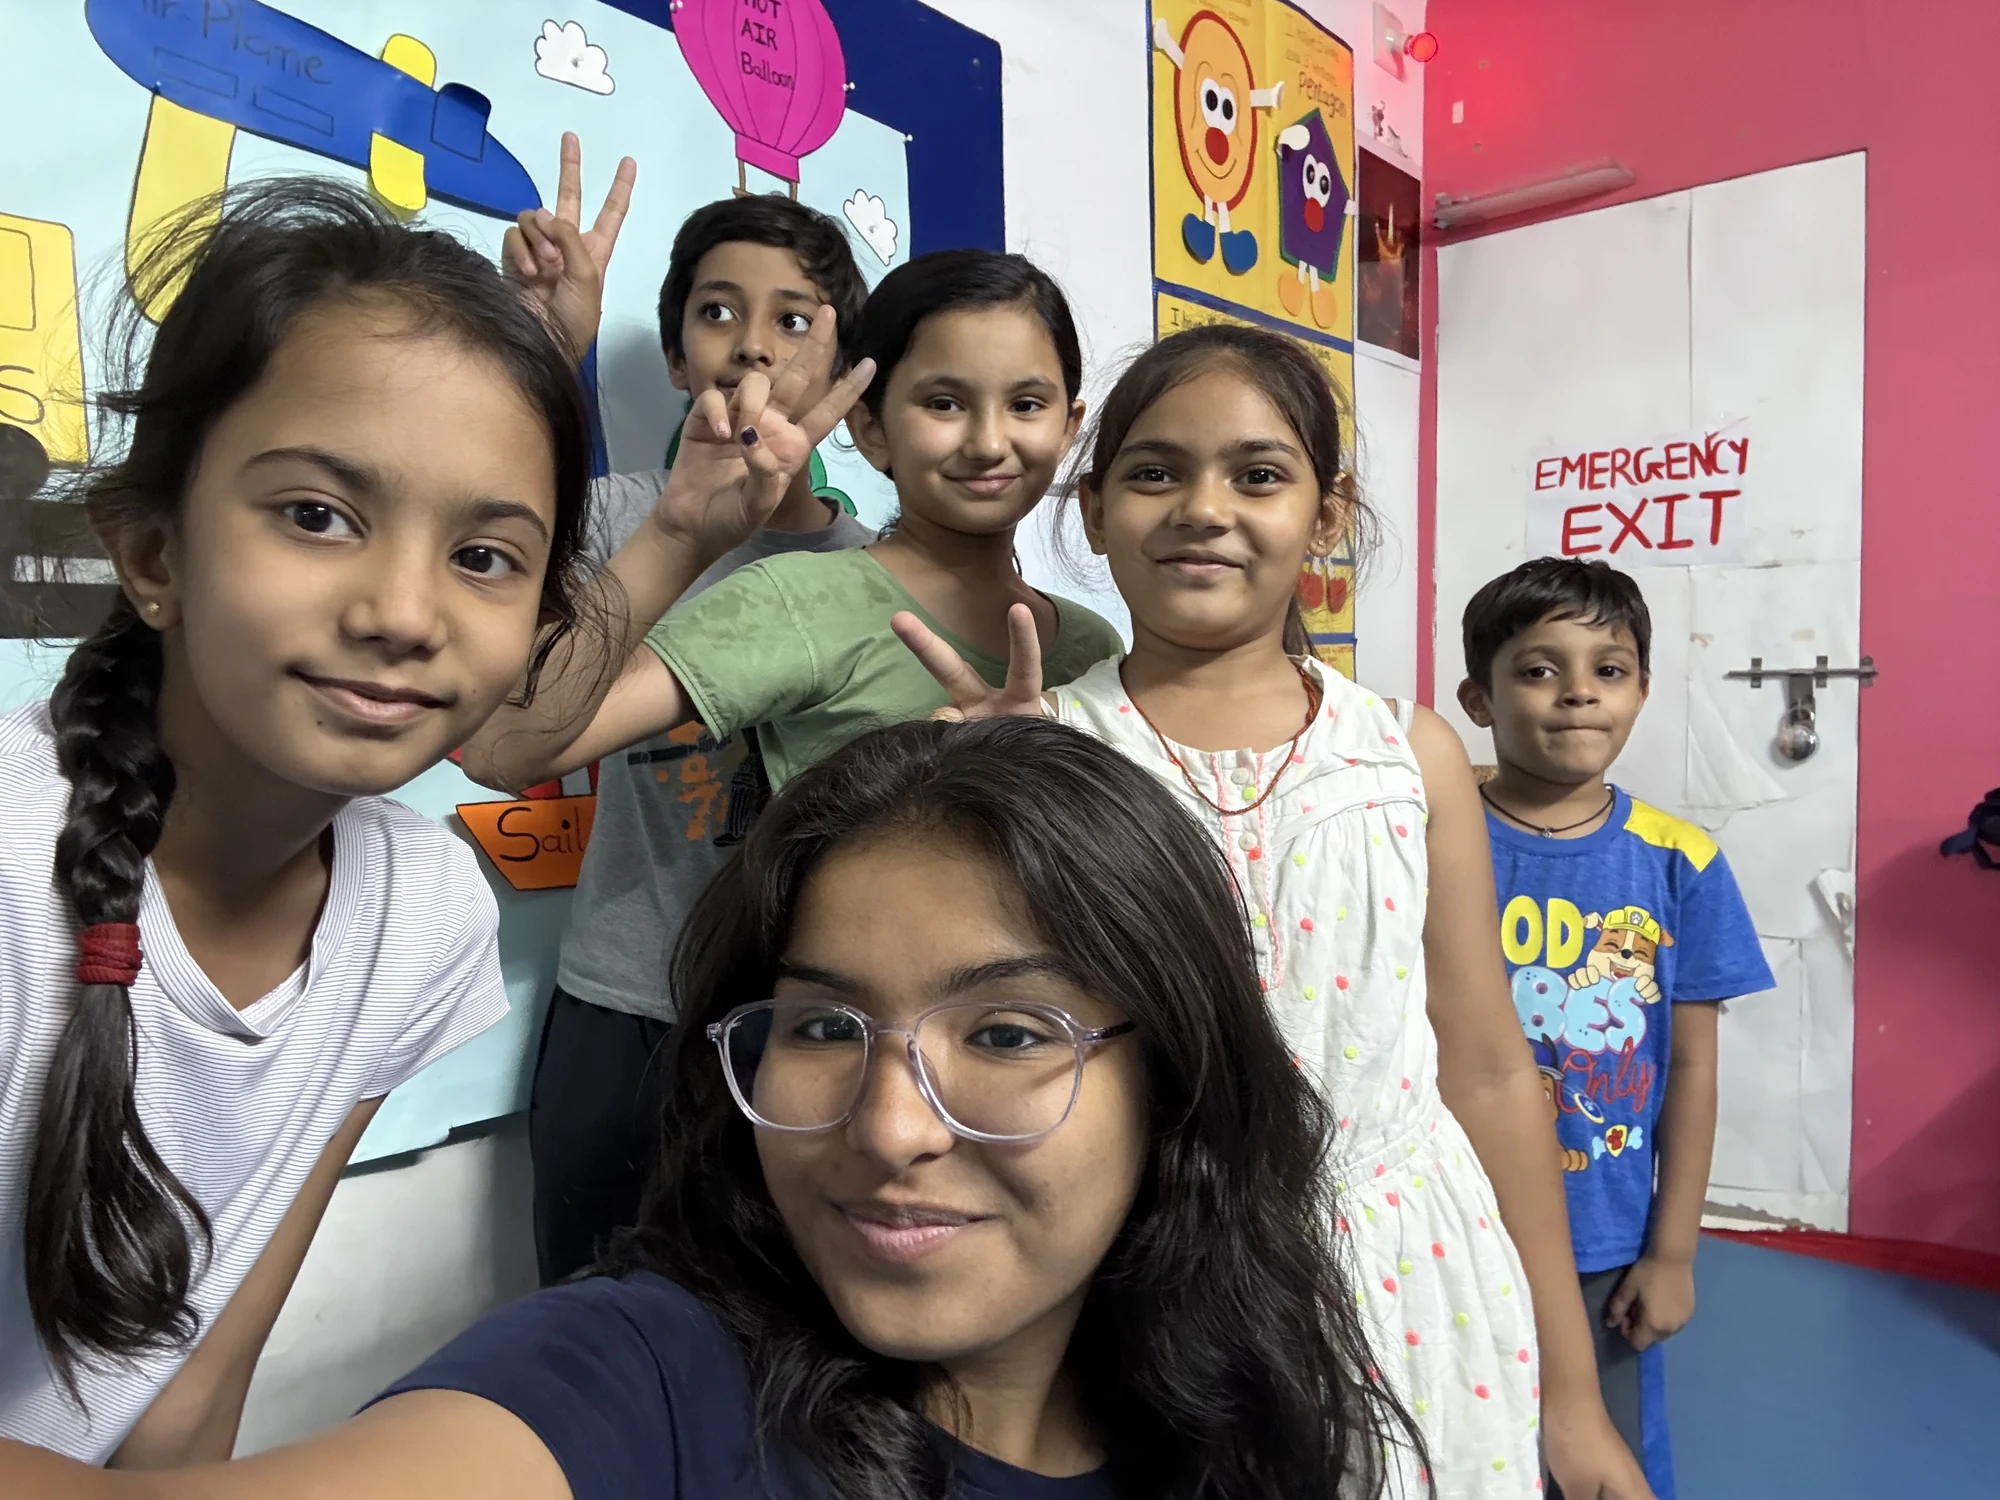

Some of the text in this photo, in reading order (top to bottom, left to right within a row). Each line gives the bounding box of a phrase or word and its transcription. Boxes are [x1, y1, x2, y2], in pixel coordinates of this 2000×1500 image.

[741, 17, 778, 51] AIR
[741, 51, 795, 91] Balloon
[1534, 431, 1749, 491] EMERGENCY
[1561, 489, 1742, 556] EXIT
[496, 806, 584, 863] Sail
[1555, 1036, 1657, 1114] Only
